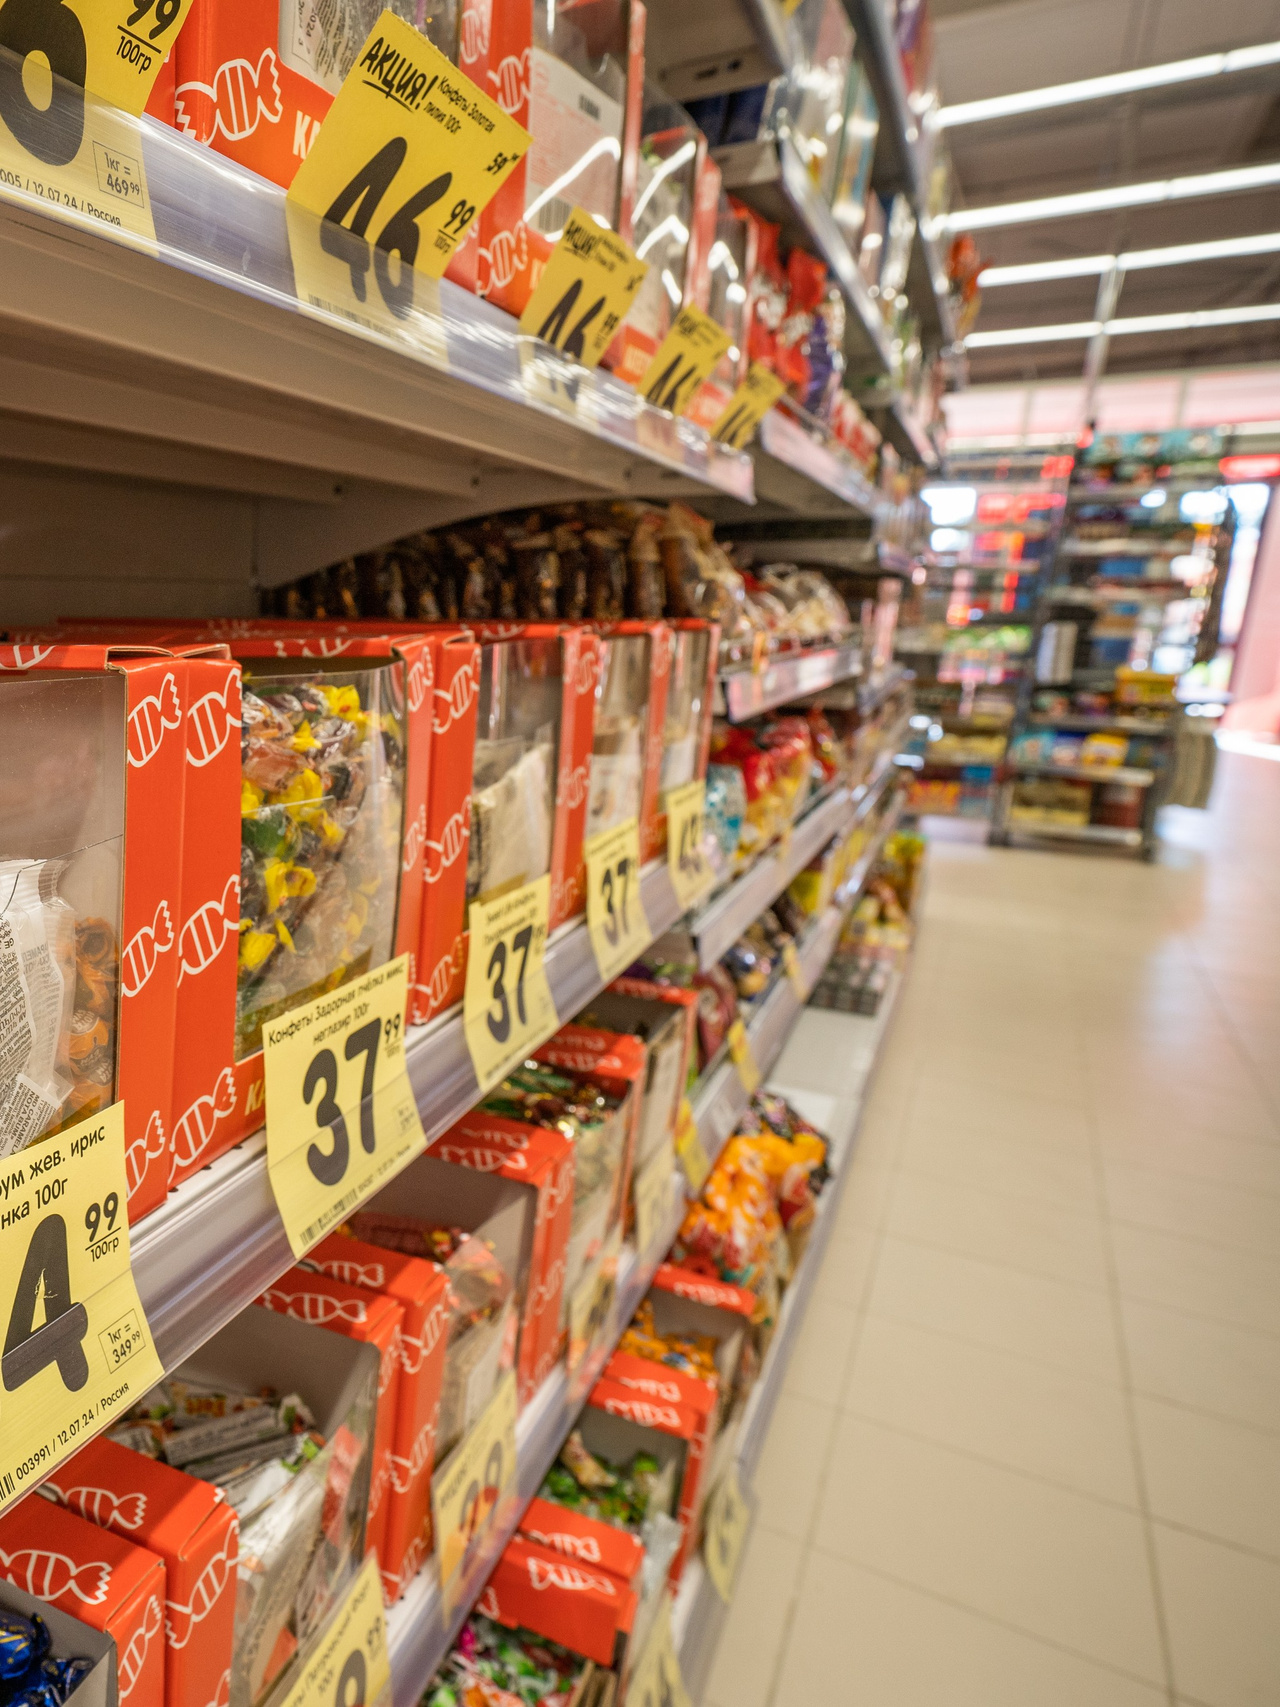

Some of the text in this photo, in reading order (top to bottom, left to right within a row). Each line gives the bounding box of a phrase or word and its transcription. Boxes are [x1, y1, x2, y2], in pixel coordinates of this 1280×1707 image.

[116, 35, 152, 75] 100гр
[359, 36, 439, 111] АКЦИЯ!
[437, 75, 497, 134] Конфеты Золотая
[32, 182, 78, 211] 12.07.24
[87, 203, 122, 227] Россия
[319, 136, 453, 322] 46
[448, 199, 476, 234] 99
[600, 857, 632, 947] 37
[3, 937, 14, 949] GE
[486, 922, 533, 1043] 37
[268, 1012, 314, 1047] Конфеты
[315, 989, 356, 1020] Задорная
[384, 1012, 401, 1043] 99
[20, 1090, 35, 1115] NOTA
[302, 1016, 382, 1187] 37
[28, 1149, 67, 1179] жев.
[70, 1124, 106, 1161] ирис
[34, 1175, 69, 1213] 100г
[84, 1191, 119, 1243] 99
[90, 1234, 120, 1264] 100гр
[106, 1325, 123, 1345] 1кг
[15, 1445, 51, 1481] 003991
[56, 1408, 95, 1447] 12.07.24
[101, 1381, 130, 1411] Россия
